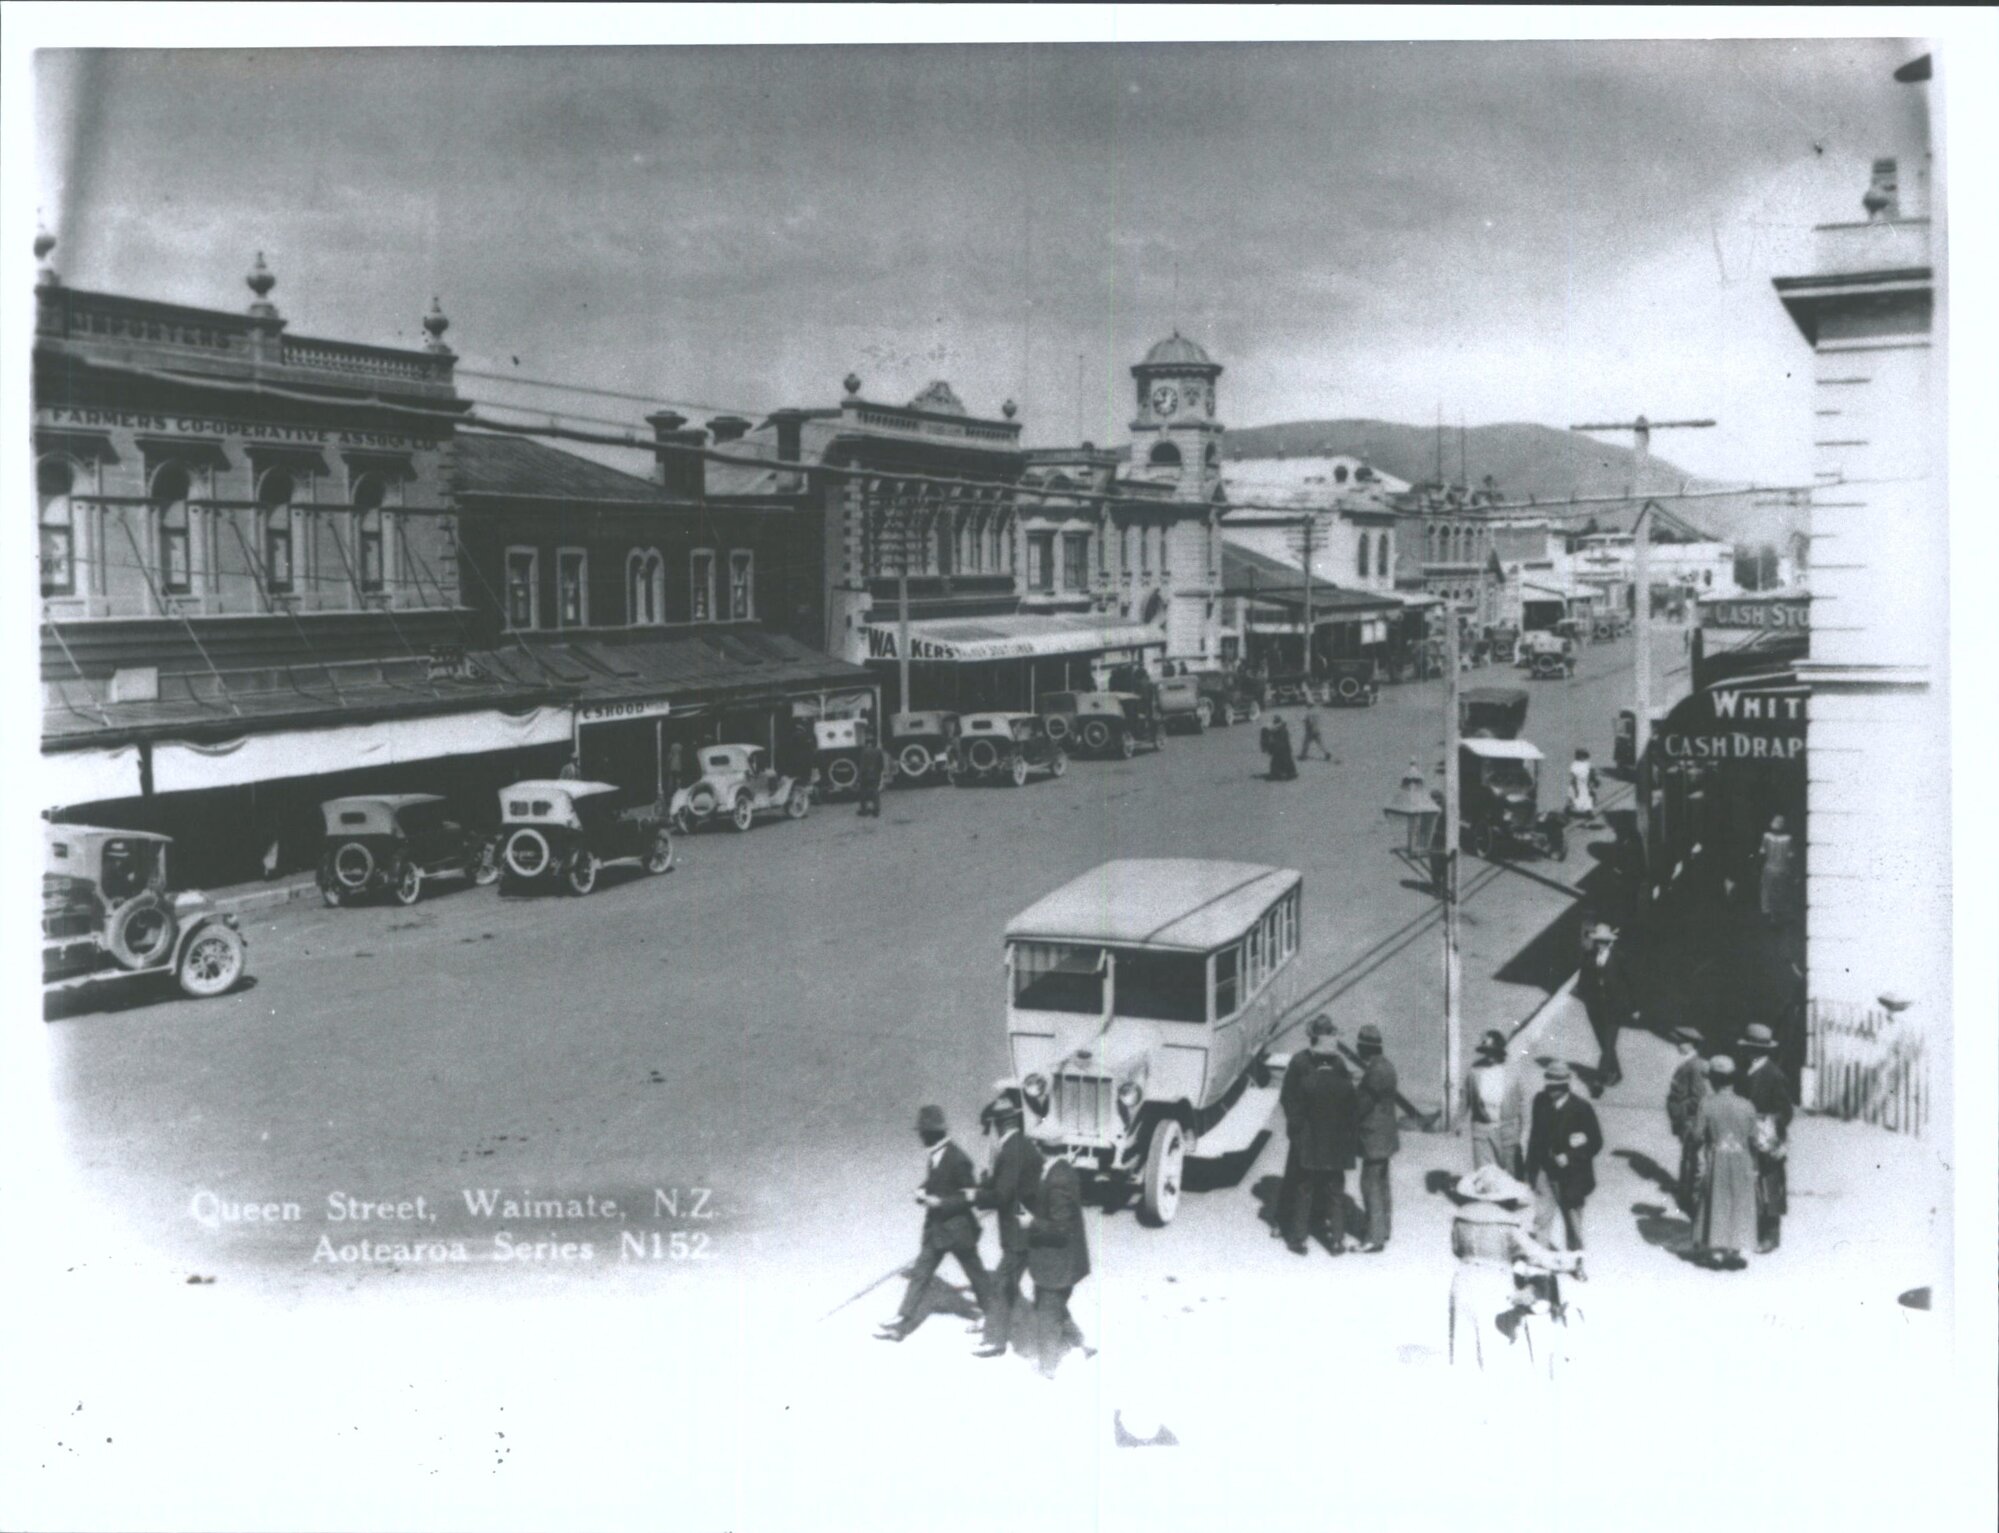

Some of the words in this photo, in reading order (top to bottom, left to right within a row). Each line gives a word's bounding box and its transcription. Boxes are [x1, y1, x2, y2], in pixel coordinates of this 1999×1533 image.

[52, 408, 167, 430] FARMERS
[177, 417, 329, 442] CO-OPERATIVE
[1716, 604, 1765, 625] CASH
[1712, 690, 1801, 719] WHIT
[1665, 733, 1727, 757] CASH
[1734, 731, 1803, 758] DRAP
